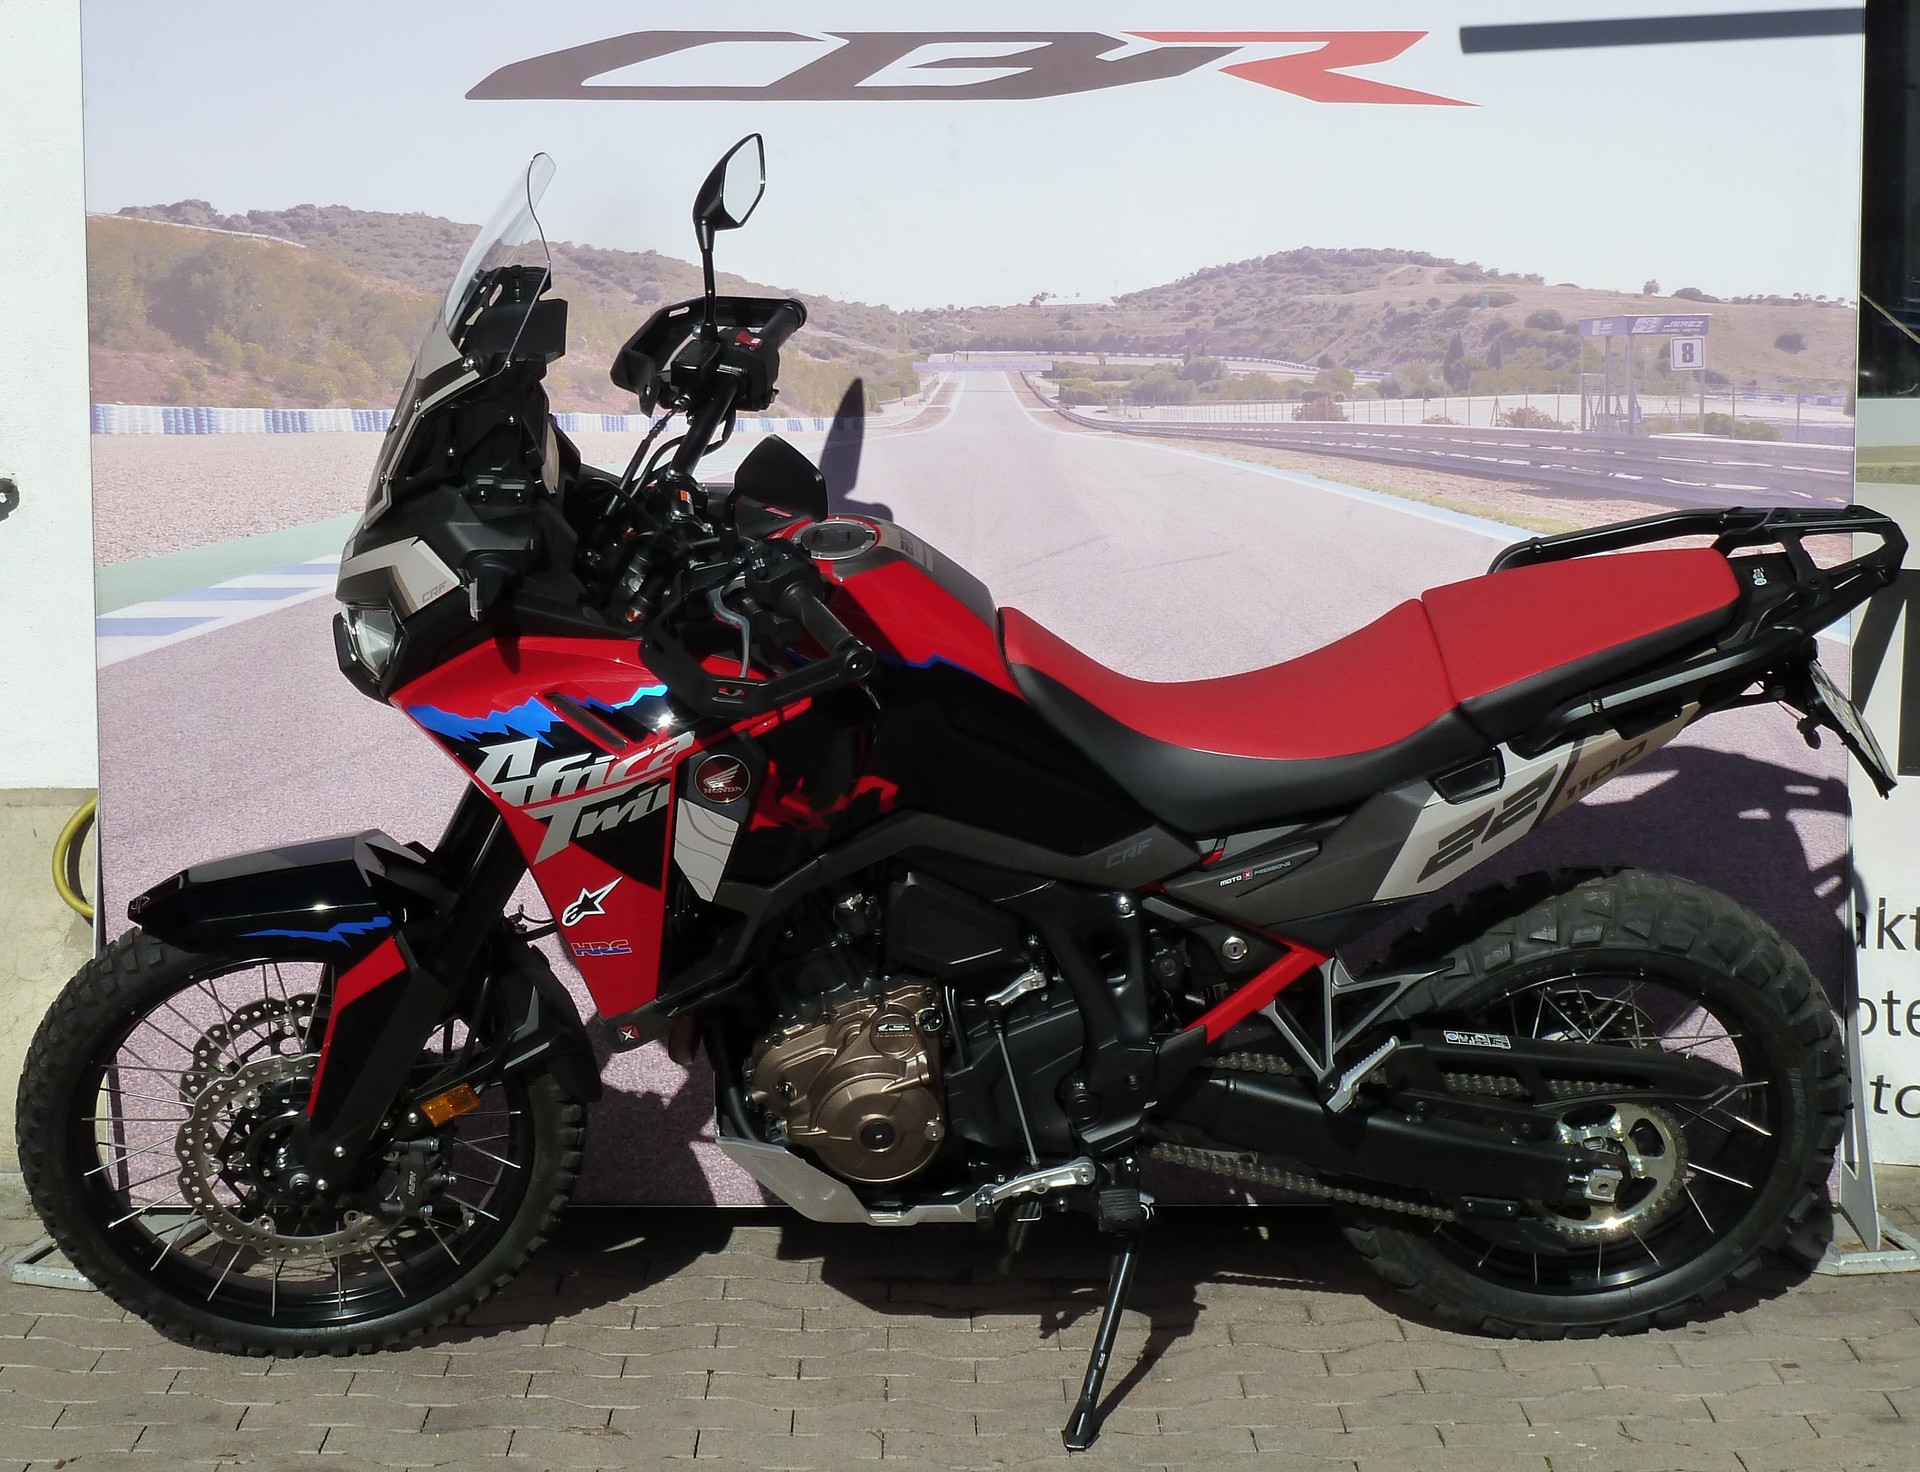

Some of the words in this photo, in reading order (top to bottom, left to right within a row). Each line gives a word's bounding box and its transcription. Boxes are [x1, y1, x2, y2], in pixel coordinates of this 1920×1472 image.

[465, 30, 1482, 107] CBR
[1681, 342, 1694, 363] 8
[422, 580, 448, 604] CRF
[475, 731, 695, 807] Africa
[1565, 739, 1649, 800] 1100
[703, 786, 742, 794] HONDA
[1105, 838, 1153, 869] CRF
[571, 940, 632, 956] HRC
